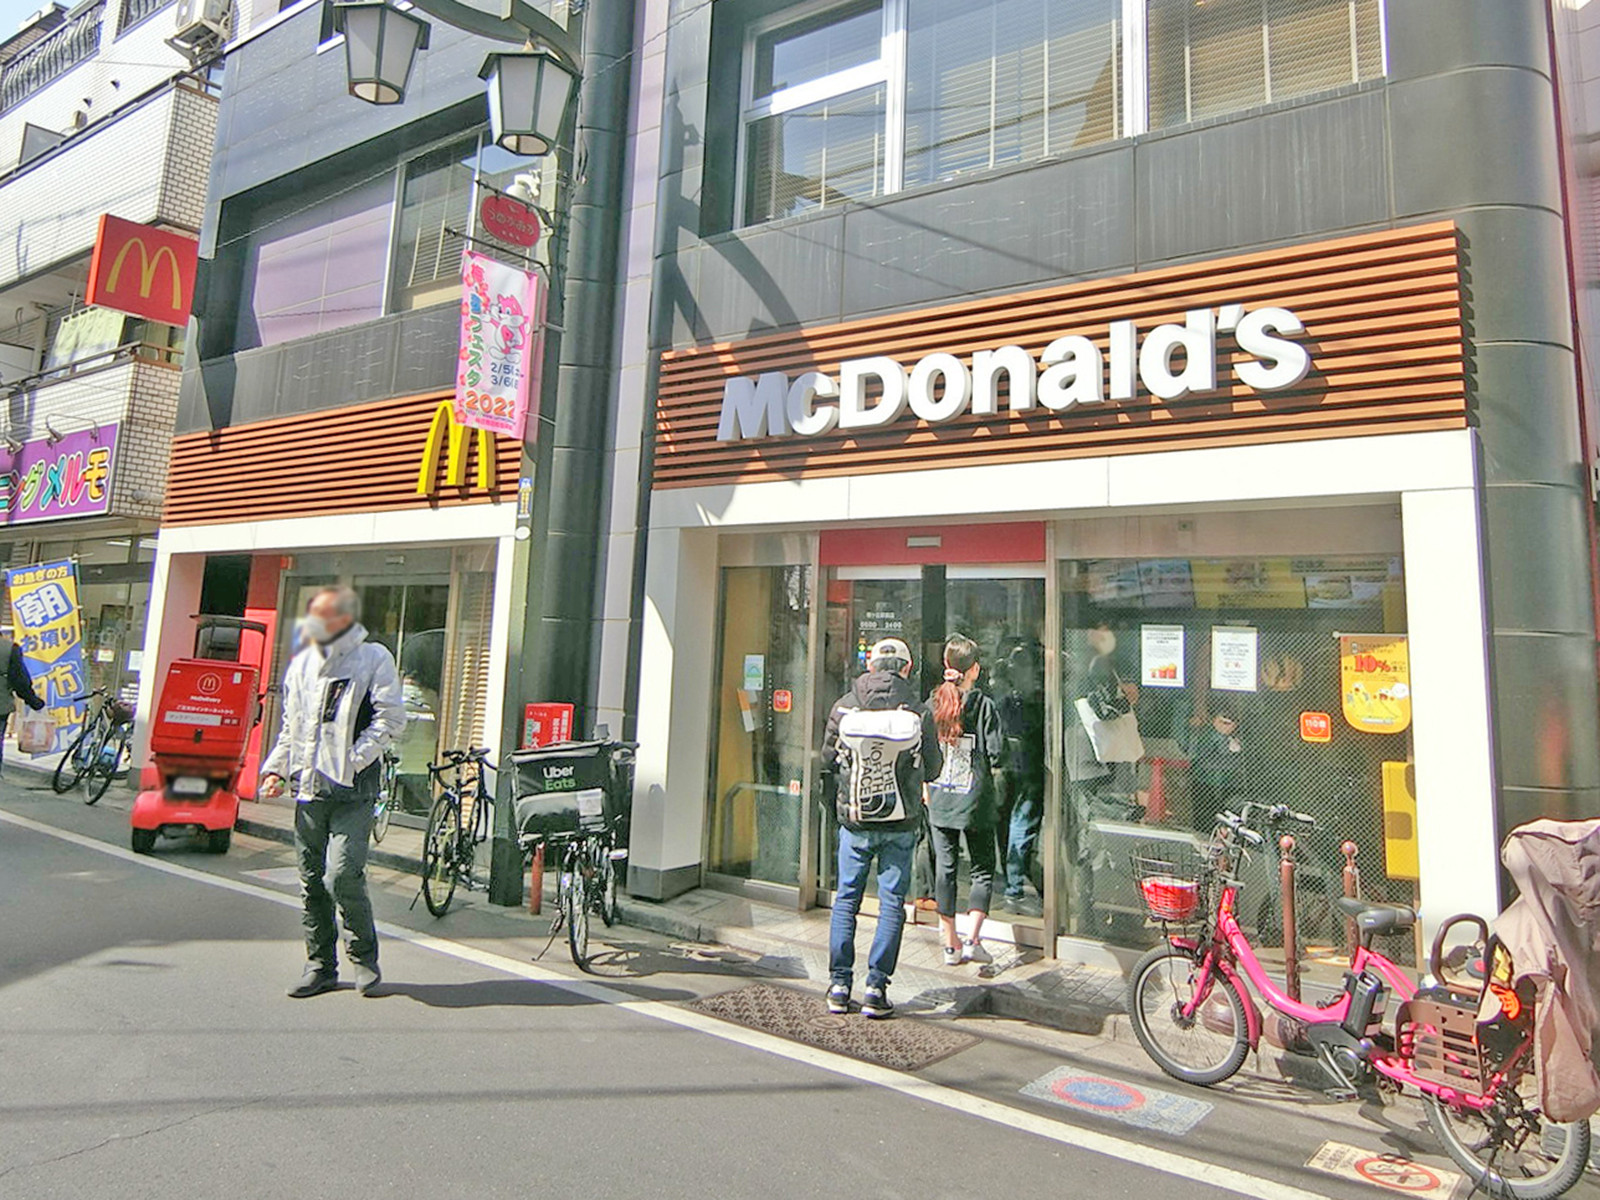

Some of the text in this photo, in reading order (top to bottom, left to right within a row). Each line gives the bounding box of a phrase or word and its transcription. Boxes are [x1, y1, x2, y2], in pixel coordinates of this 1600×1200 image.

[716, 304, 1311, 442] McDonald's
[15, 583, 73, 628] 朝
[542, 765, 575, 779] Uber
[544, 778, 577, 791] Eats
[860, 757, 873, 797] FACE
[871, 741, 885, 794] NORTH
[882, 760, 896, 791] THE
